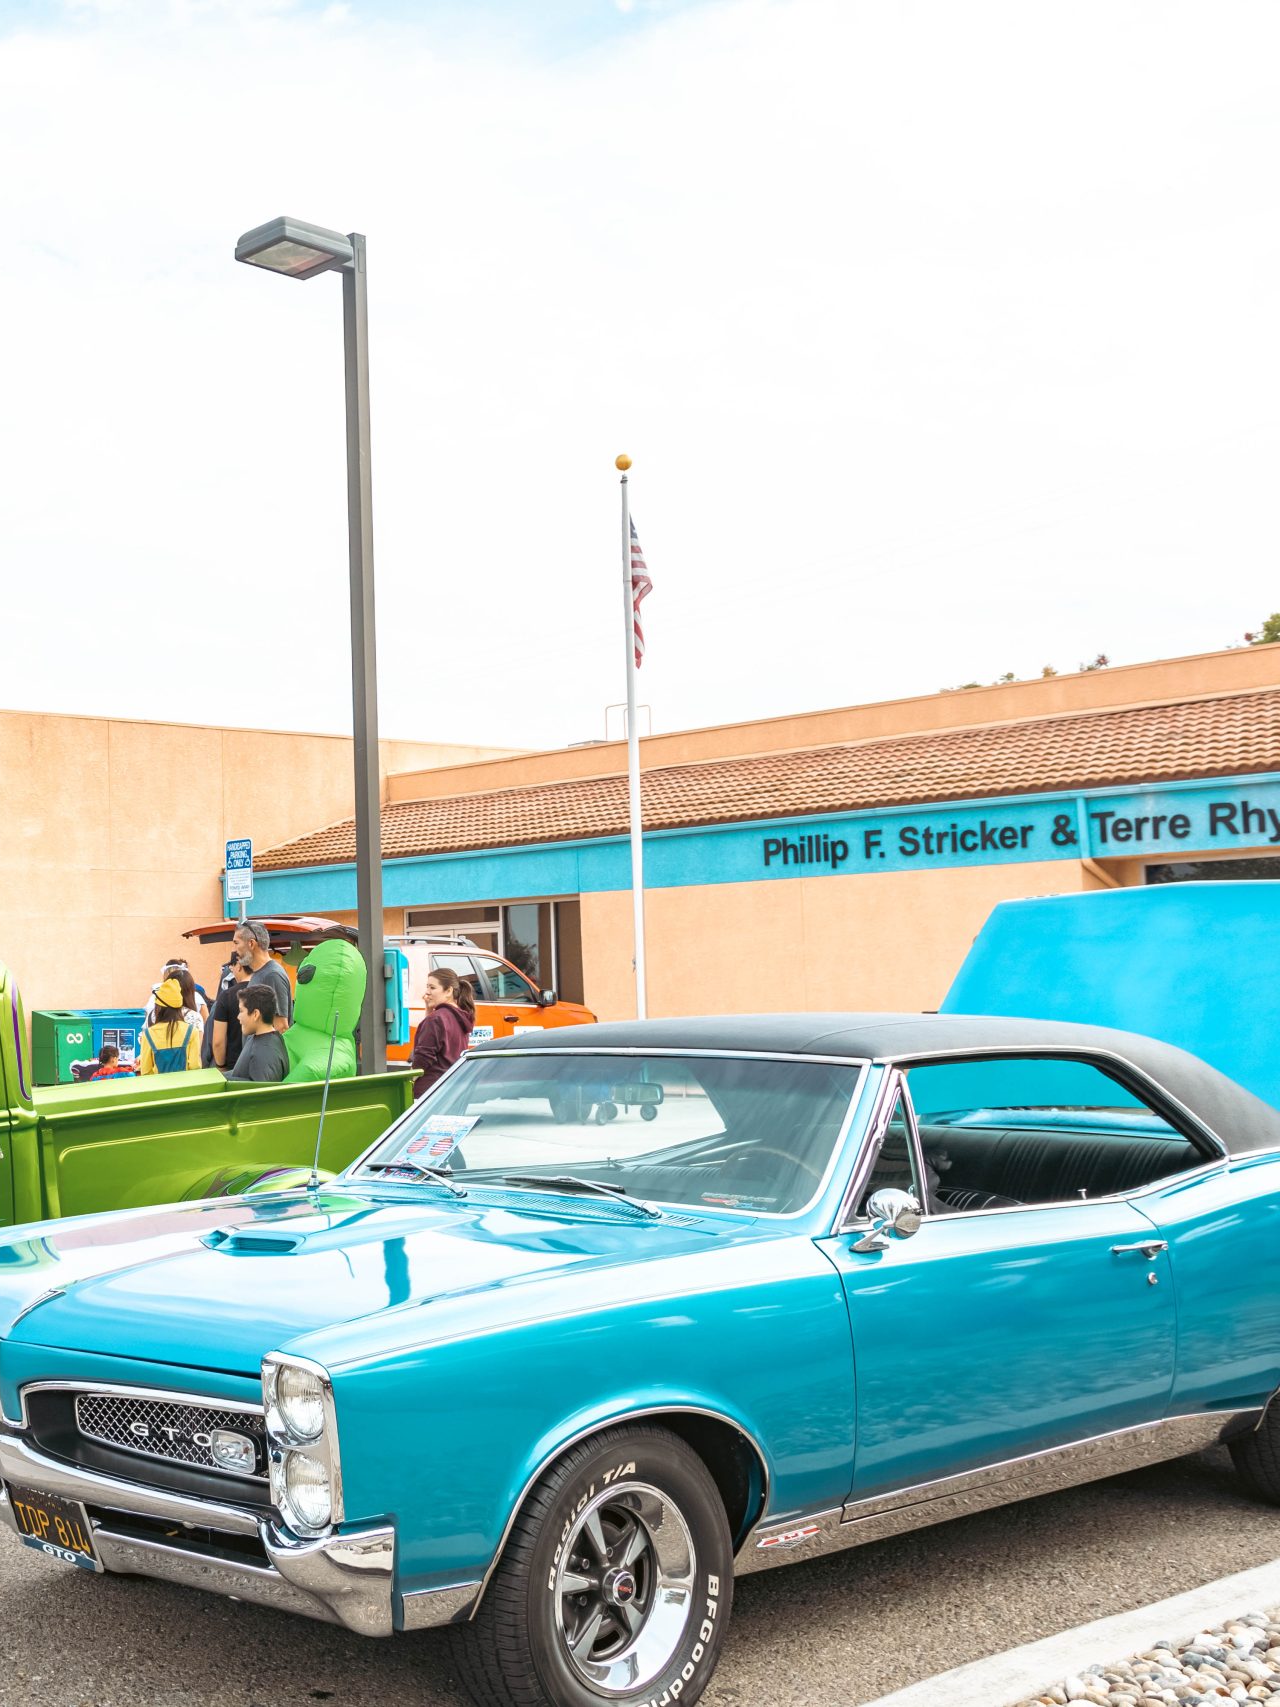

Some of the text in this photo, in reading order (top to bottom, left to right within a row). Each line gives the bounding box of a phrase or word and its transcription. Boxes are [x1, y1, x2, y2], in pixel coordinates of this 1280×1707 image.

[763, 833, 849, 869] Phillip
[864, 829, 886, 859] F.
[898, 820, 1034, 857] Stricker
[1050, 814, 1078, 847] &
[1090, 811, 1192, 844] Terre
[14, 1500, 50, 1539] TDP
[548, 1461, 637, 1591] Radial T/A
[42, 1543, 77, 1563] GTO
